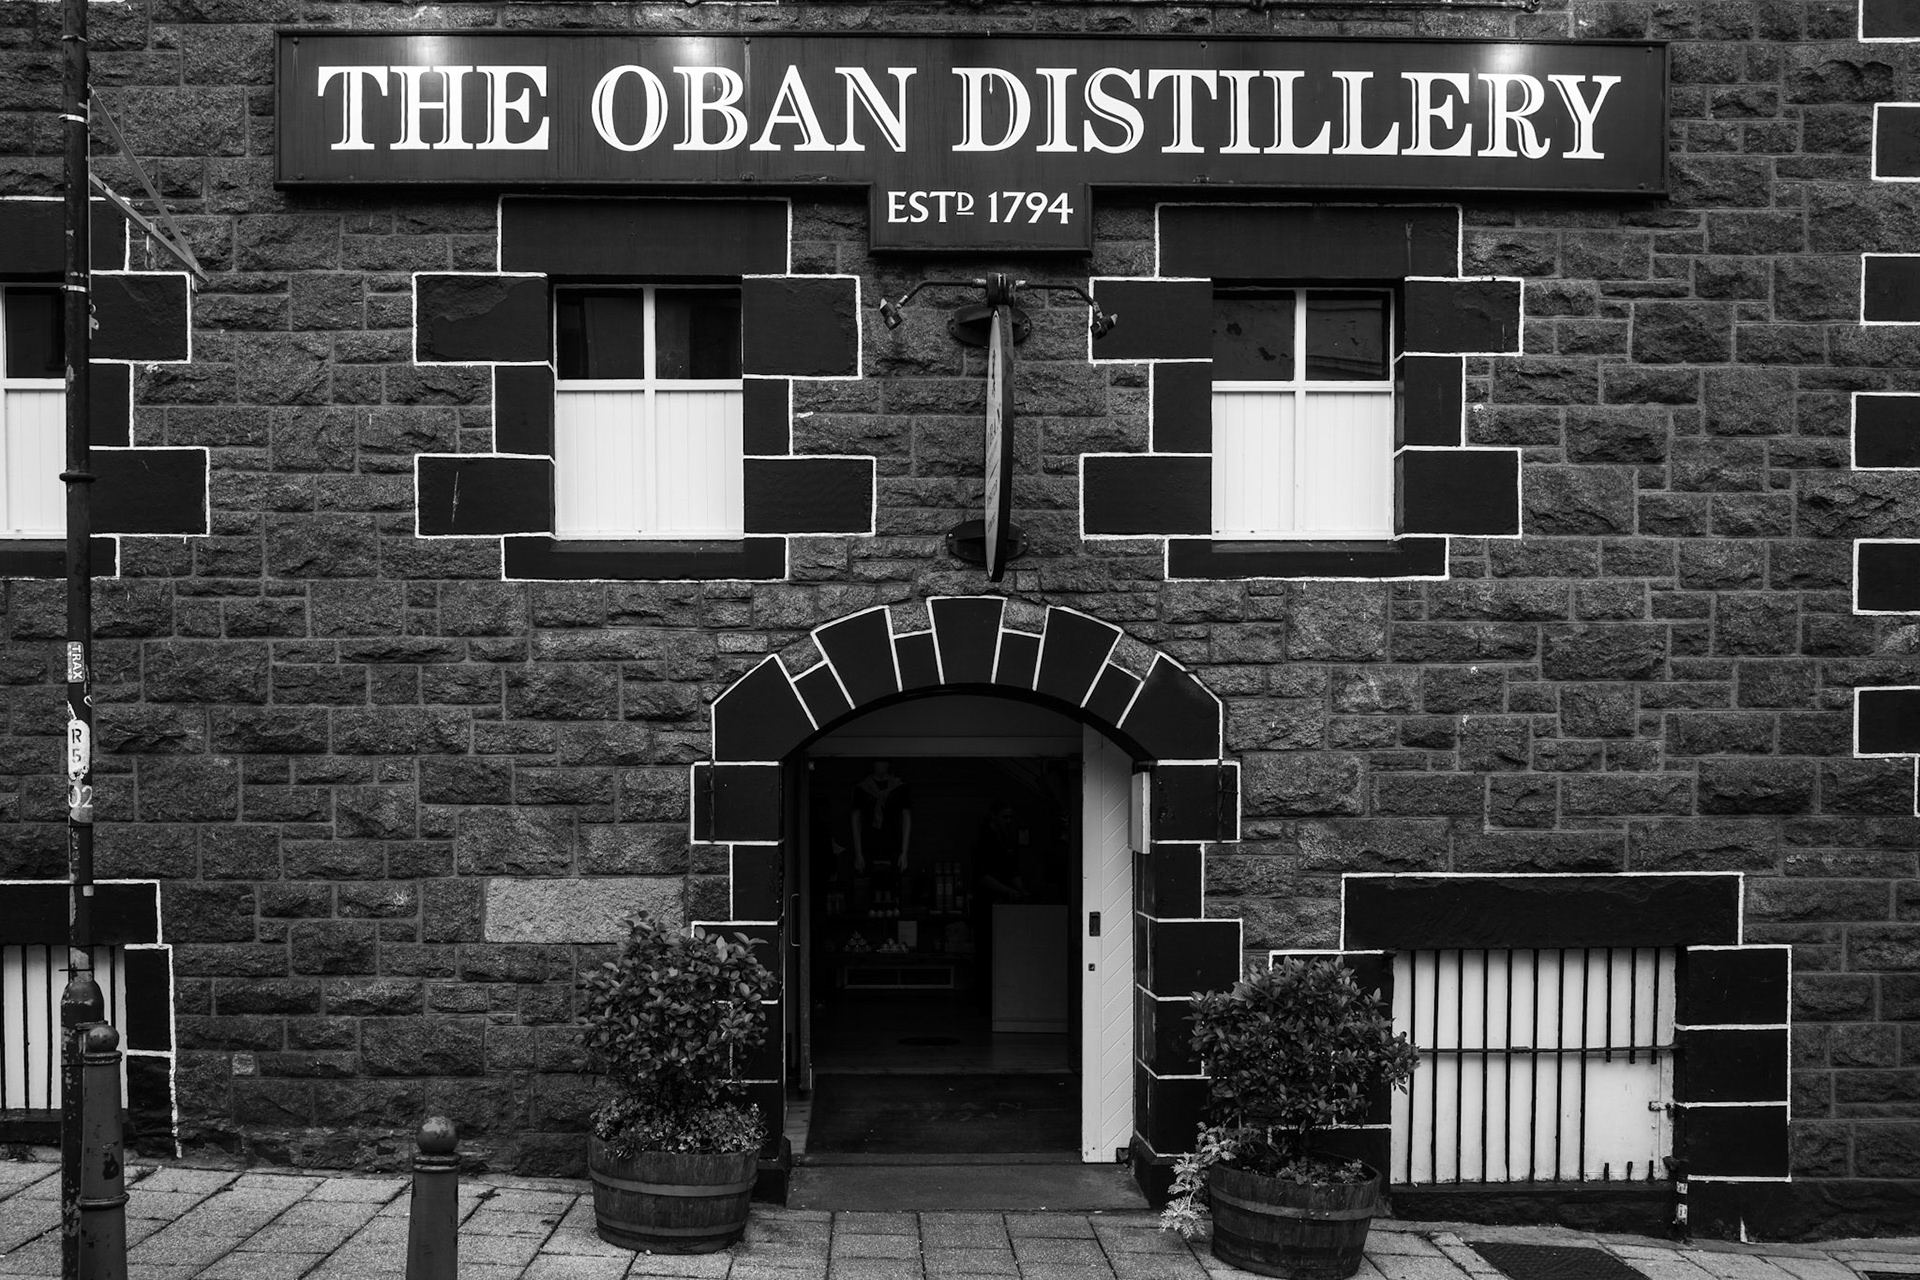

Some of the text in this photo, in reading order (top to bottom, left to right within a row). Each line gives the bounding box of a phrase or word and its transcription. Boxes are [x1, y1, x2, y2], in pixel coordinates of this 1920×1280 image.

[317, 64, 1622, 161] THE OBAN DISTILLERY
[987, 191, 1074, 225] 1794
[71, 644, 83, 680] TRAX
[71, 728, 82, 744] R
